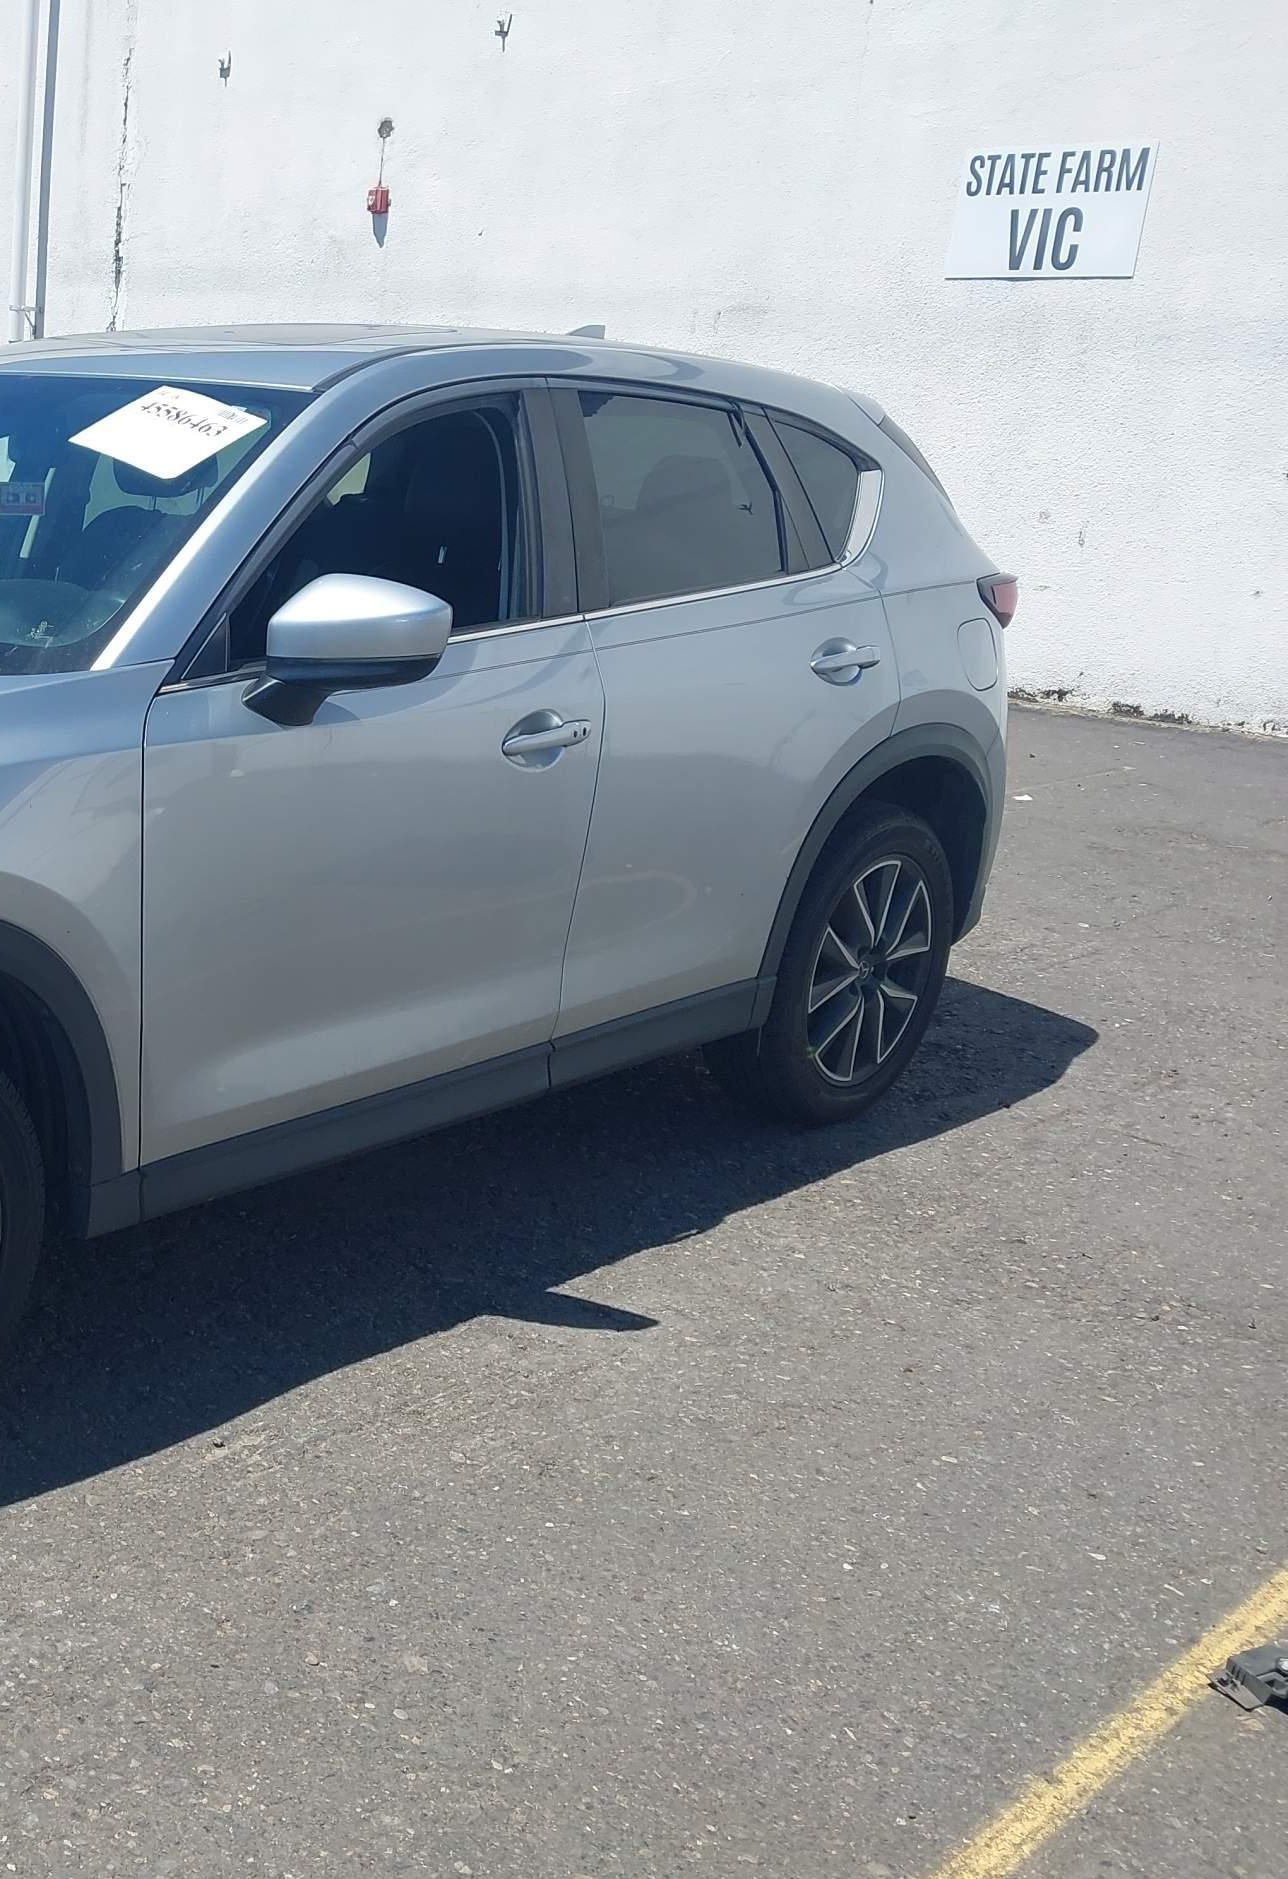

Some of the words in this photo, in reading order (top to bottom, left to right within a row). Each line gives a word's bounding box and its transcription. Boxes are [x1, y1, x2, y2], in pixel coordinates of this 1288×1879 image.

[966, 152, 1052, 197] STATE
[1055, 147, 1151, 194] FARM
[1008, 207, 1084, 271] VIC
